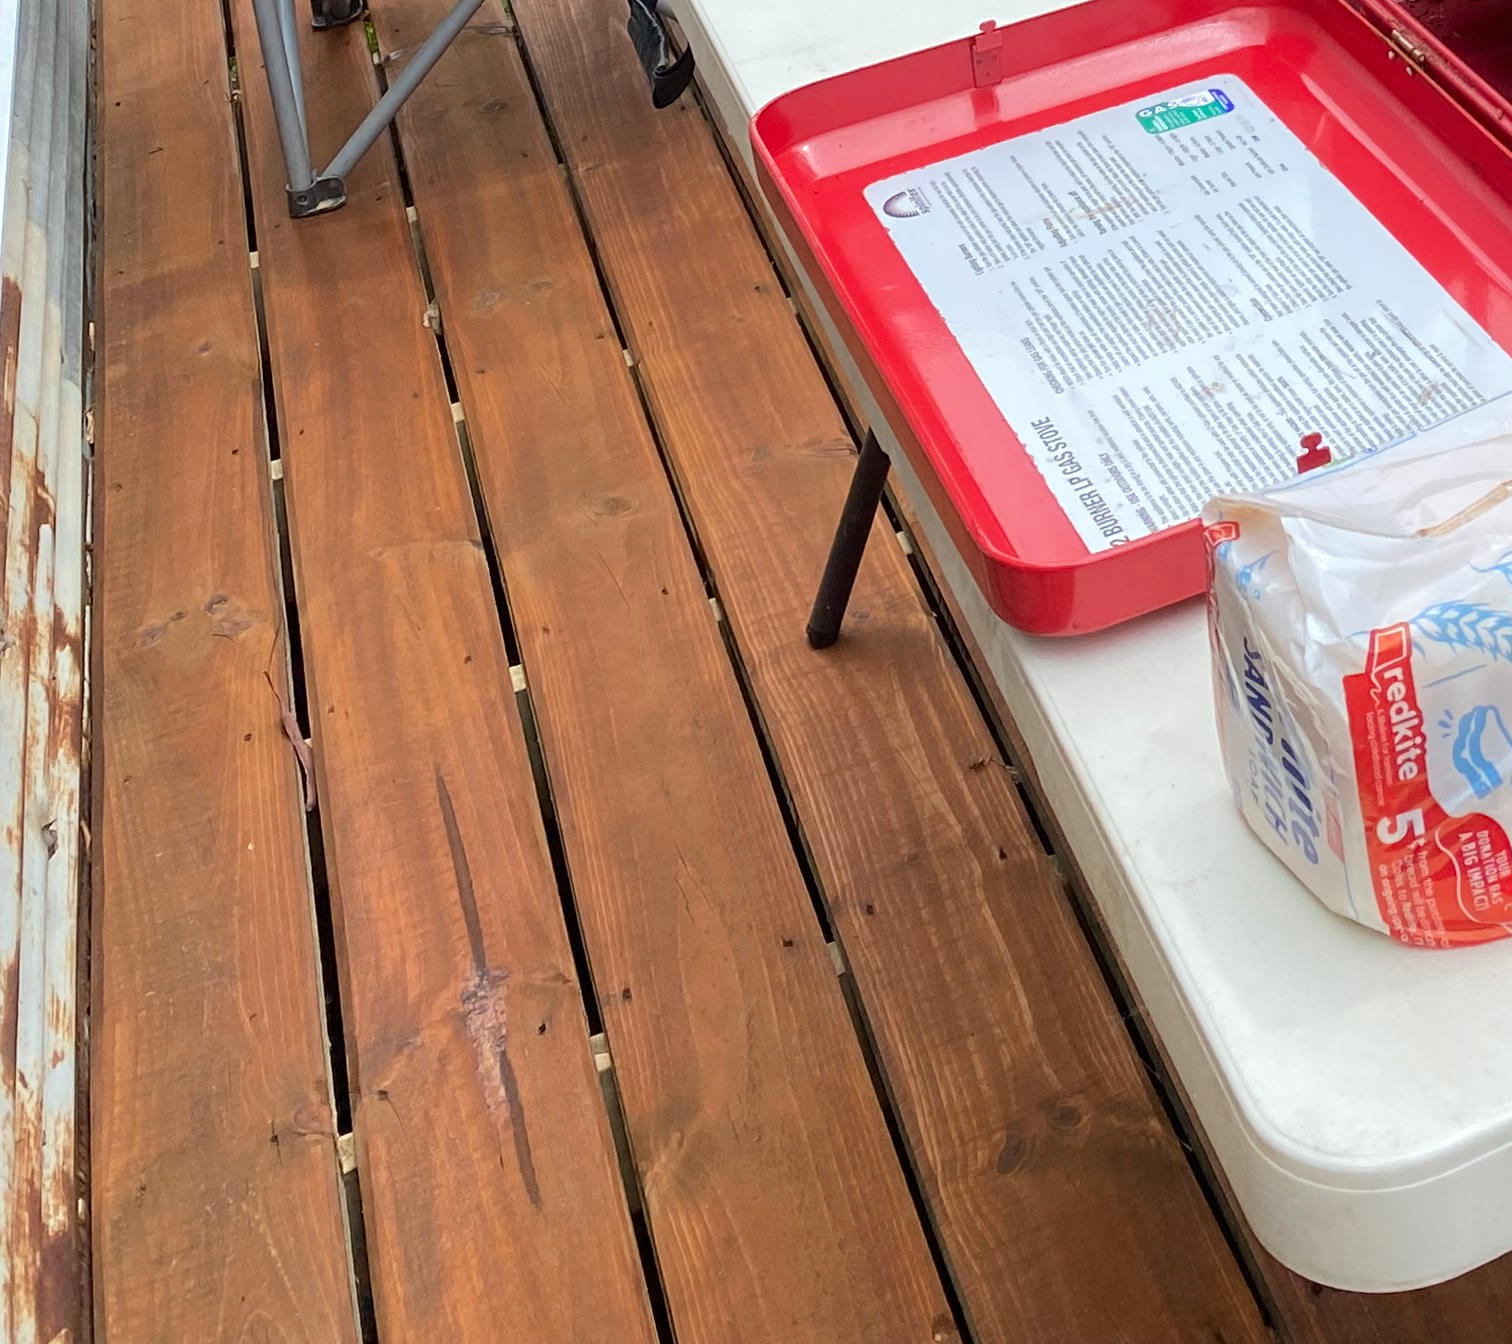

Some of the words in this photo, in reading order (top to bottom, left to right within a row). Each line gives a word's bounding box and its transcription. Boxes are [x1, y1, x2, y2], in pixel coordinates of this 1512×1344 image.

[1031, 415, 1067, 452] STOVE
[1054, 449, 1081, 474] GAS
[1068, 472, 1092, 491] LP
[1079, 488, 1123, 537] BURNER
[1110, 534, 1129, 547] 2
[1382, 667, 1421, 781] redkite
[1458, 831, 1472, 841] A
[1417, 850, 1430, 876] from
[1461, 842, 1478, 866] BIG
[1475, 829, 1497, 883] DONATION
[1494, 849, 1512, 878] YOUR
